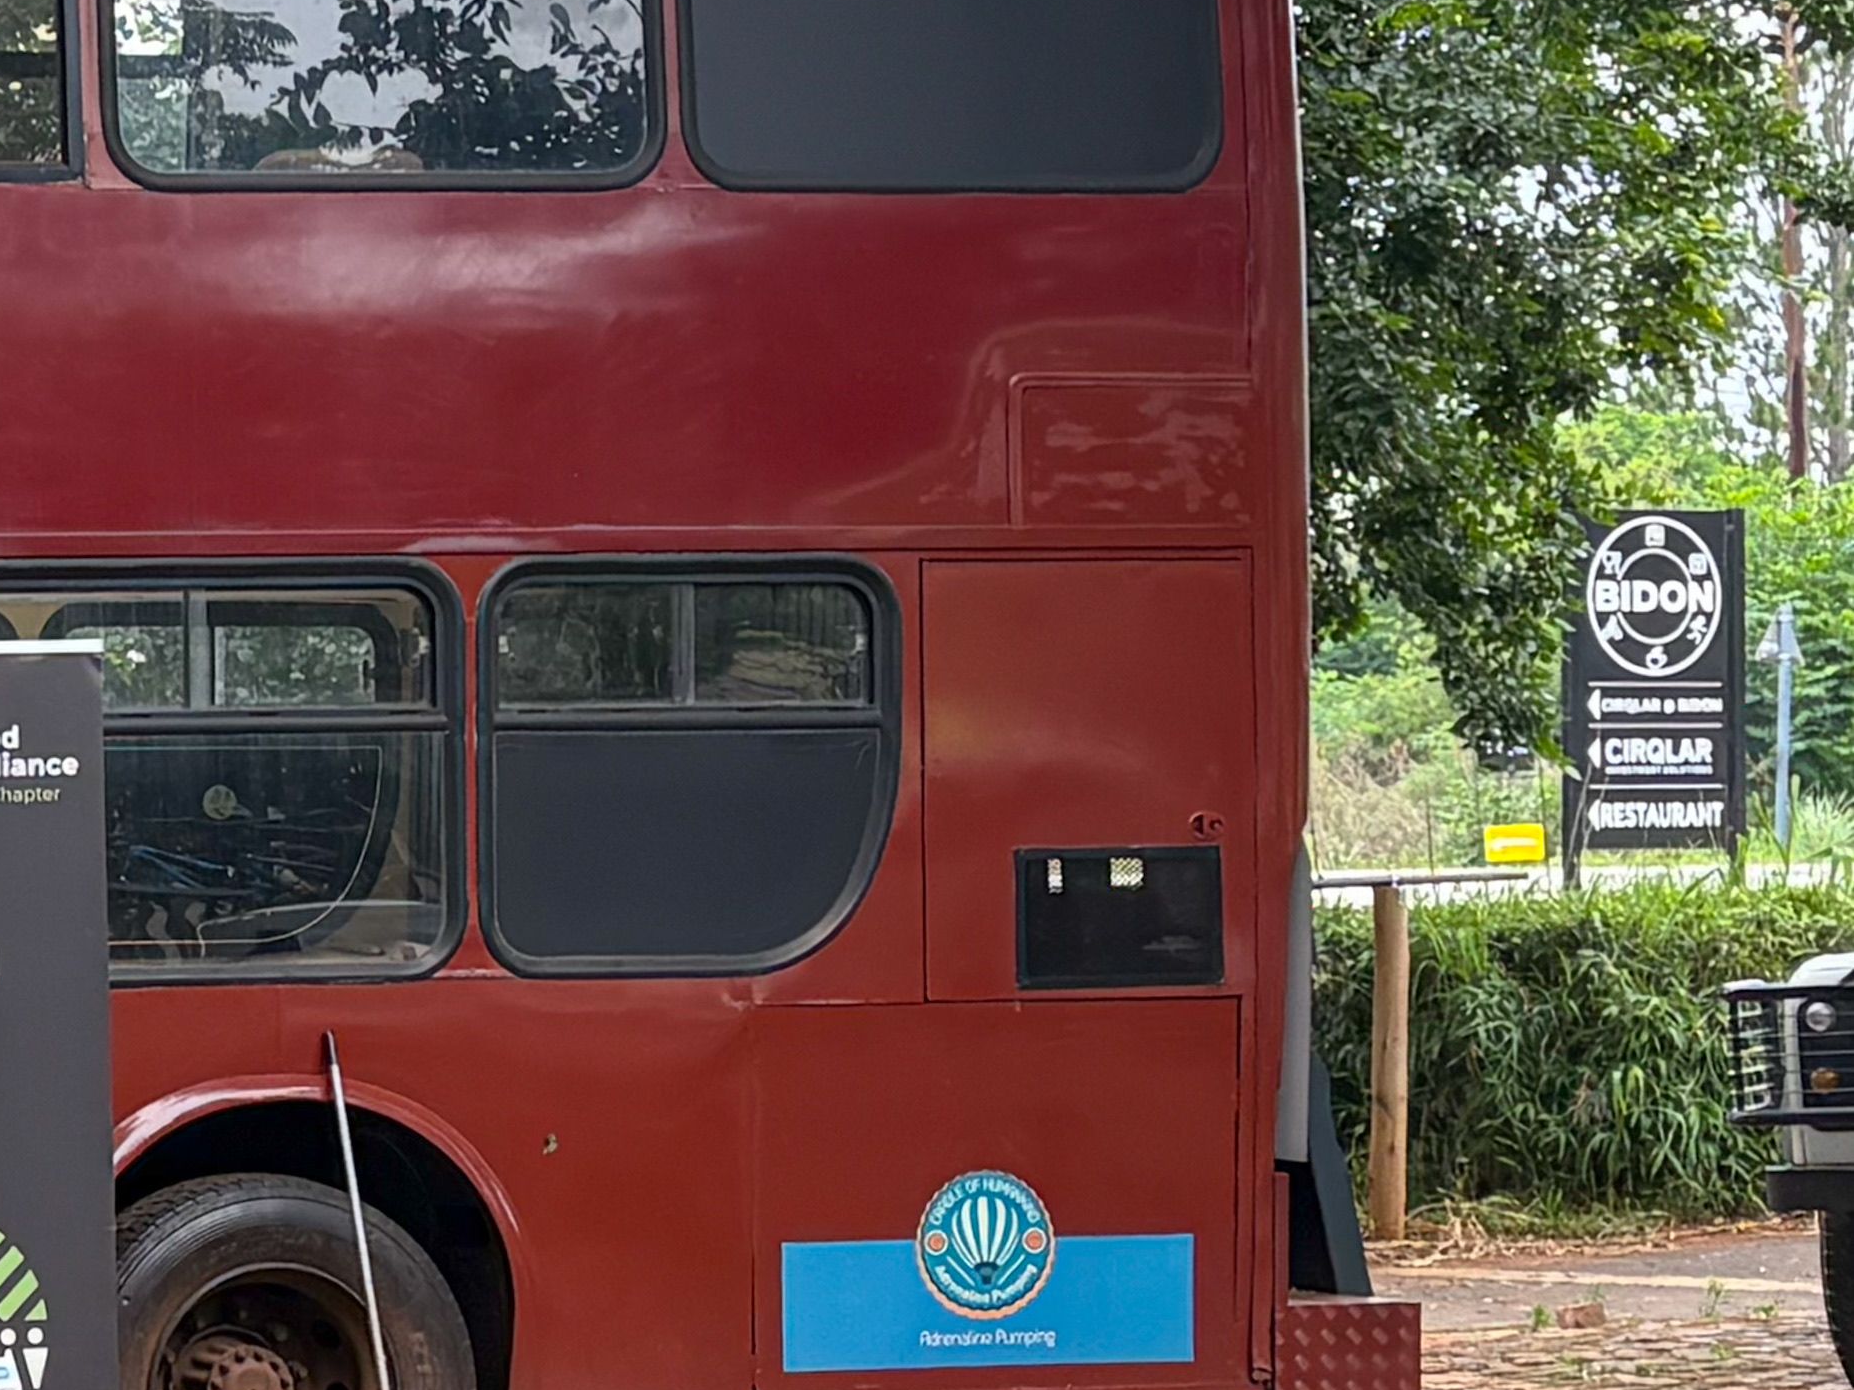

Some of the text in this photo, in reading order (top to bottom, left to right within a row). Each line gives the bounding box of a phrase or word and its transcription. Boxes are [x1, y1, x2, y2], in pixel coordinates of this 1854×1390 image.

[1594, 579, 1714, 614] BIDON
[1604, 736, 1714, 765] CIRQLAR
[1599, 800, 1724, 829] RESTAURANT
